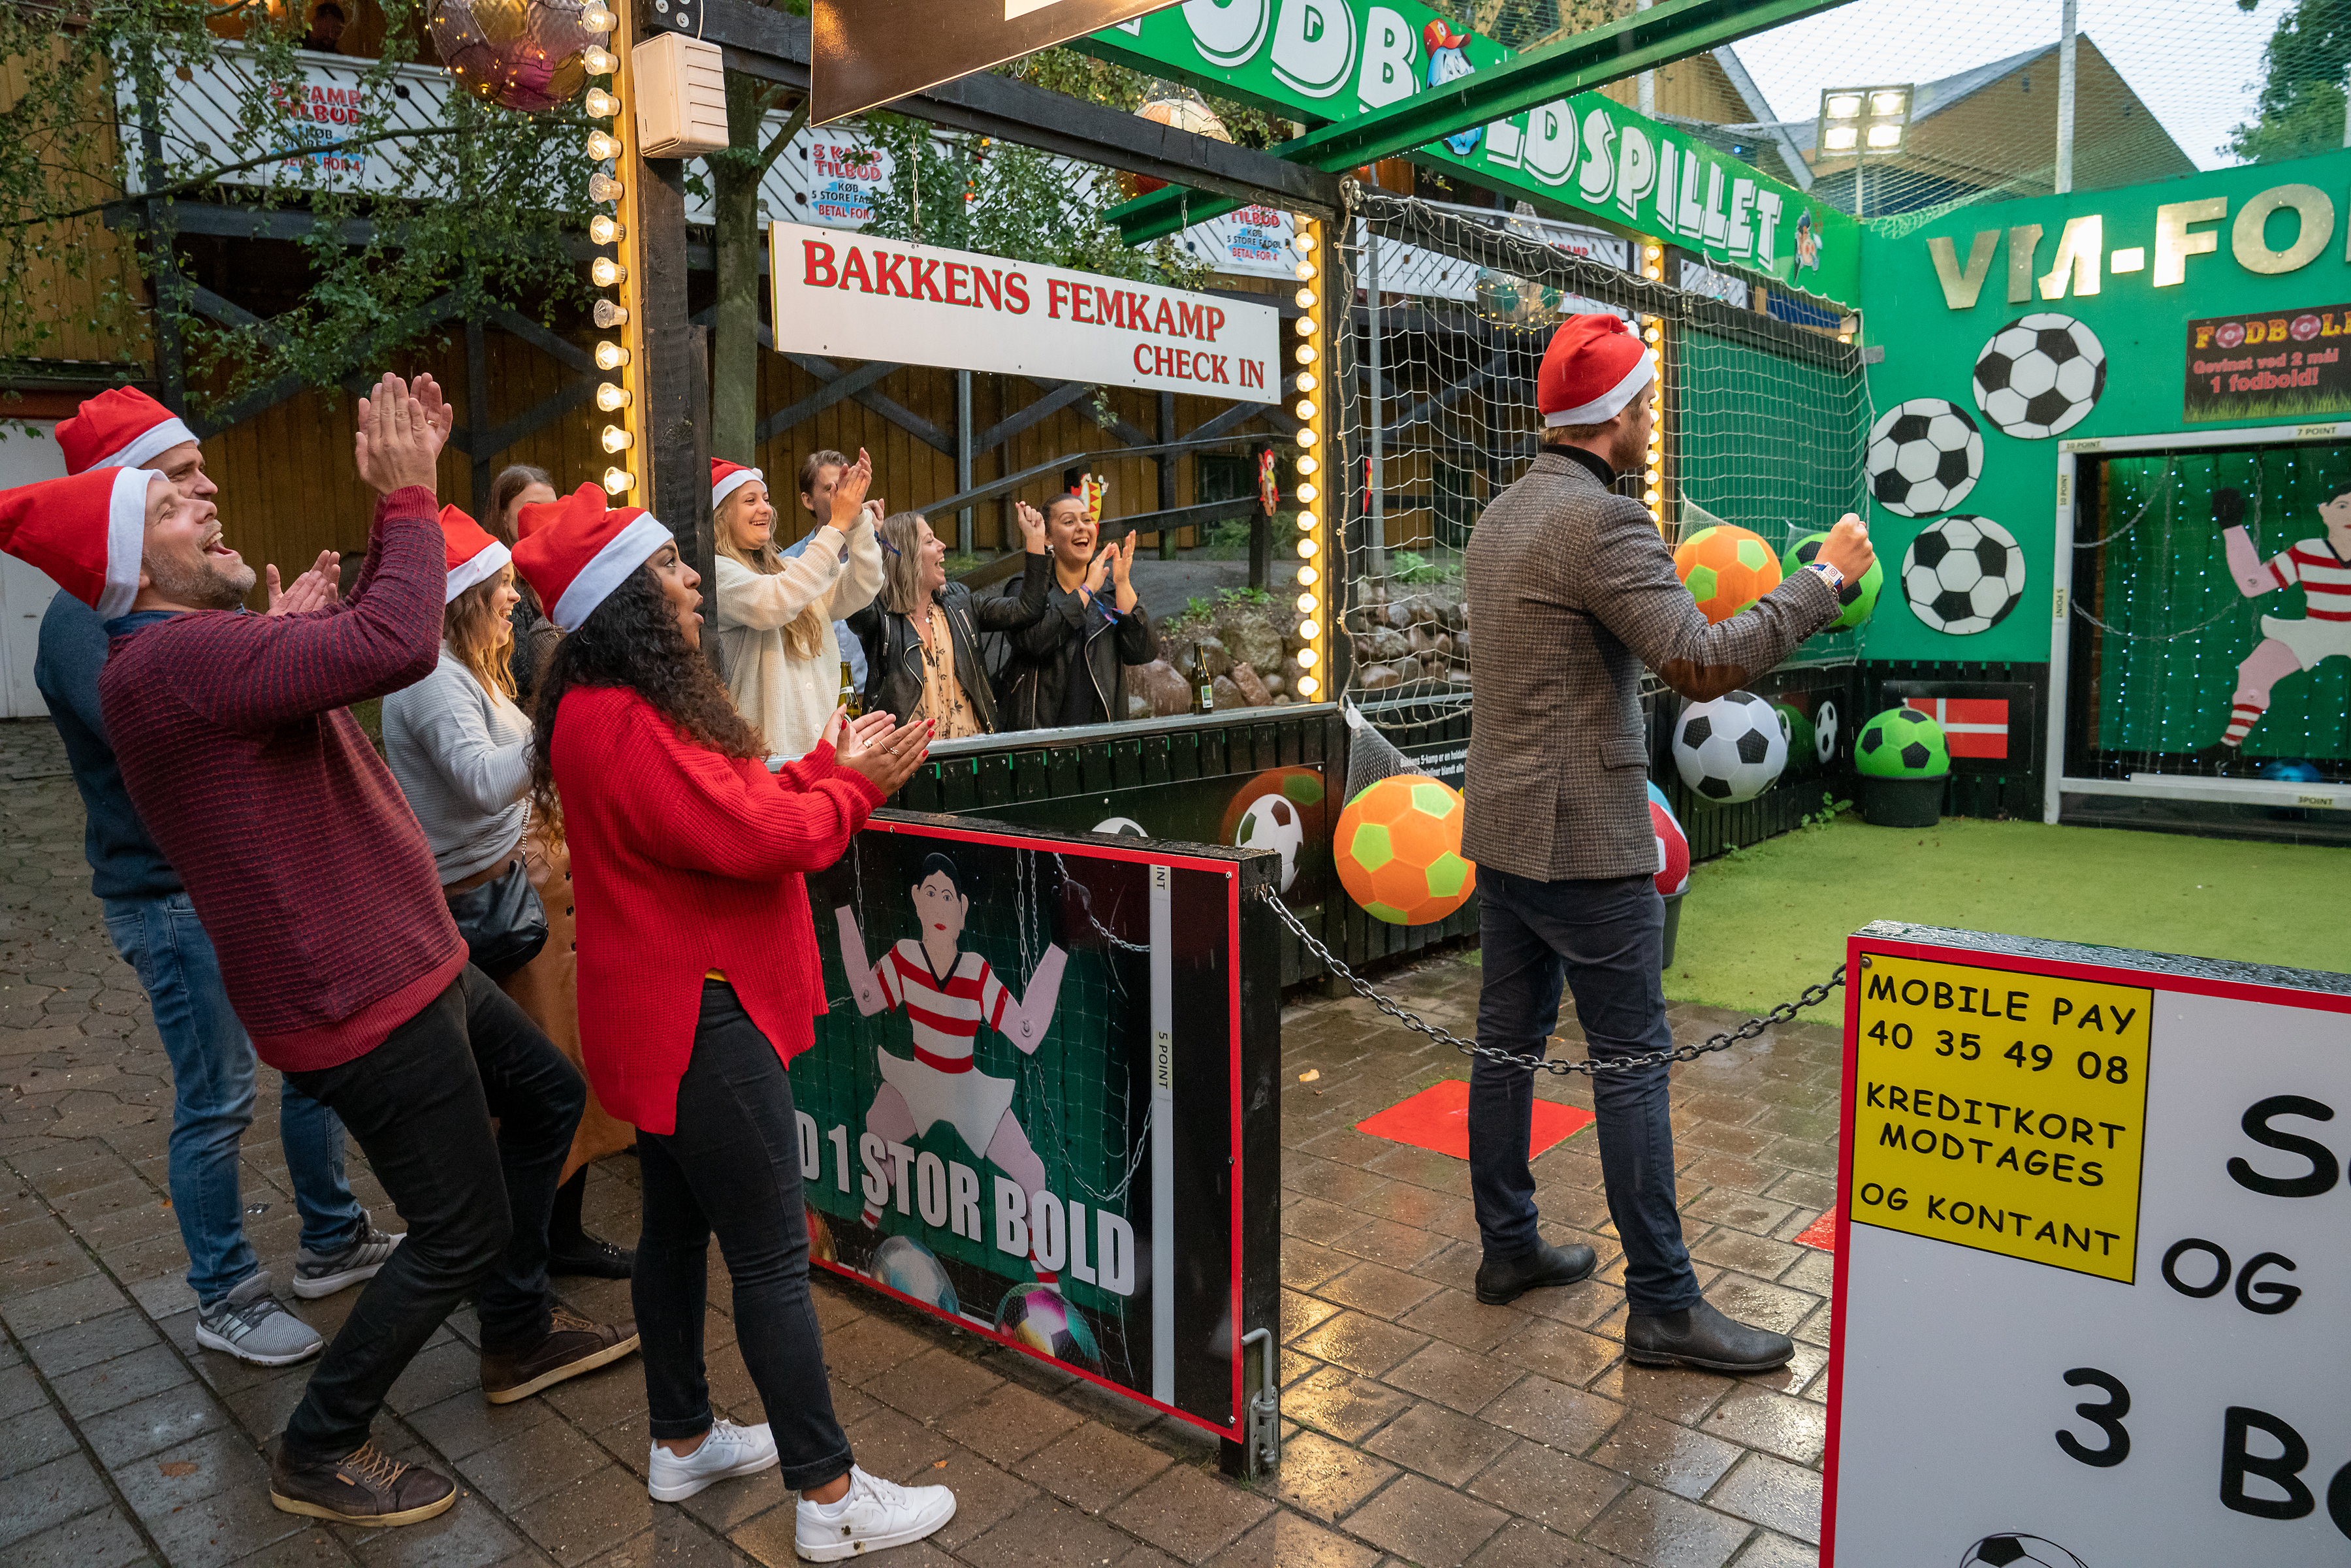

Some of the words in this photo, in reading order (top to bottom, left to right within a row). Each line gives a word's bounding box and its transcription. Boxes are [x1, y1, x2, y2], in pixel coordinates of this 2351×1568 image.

[300, 85, 362, 106] AMP
[813, 144, 824, 159] 5
[830, 146, 882, 165] KP
[814, 160, 882, 181] TILBUD
[820, 191, 850, 202] STORE
[838, 183, 858, 193] KØB
[819, 204, 847, 217] BETAL
[850, 208, 869, 220] FOR
[1230, 210, 1280, 227] TILBUD
[1234, 236, 1256, 246] STORE
[1247, 229, 1263, 238] KØB
[1232, 248, 1253, 259] BETAL
[1256, 250, 1271, 261] FOR
[802, 240, 1031, 315] BAKKENS
[1047, 278, 1225, 342] FEMKAMP
[2195, 311, 2351, 349] FODBOL
[1134, 344, 1228, 385] CHECK
[1239, 359, 1264, 389] IN
[2193, 357, 2253, 374] Gevinst
[2257, 353, 2286, 369] ved
[2291, 352, 2303, 366] 2
[2307, 348, 2339, 364] mål
[2211, 376, 2220, 393] 1
[2229, 367, 2318, 392] fodbold!
[2305, 426, 2336, 435] POINT
[2076, 440, 2101, 449] POINT
[1421, 754, 1439, 765] 5-kamp
[1867, 974, 2030, 1022] MOBILE
[2052, 997, 2136, 1036] PAY
[1867, 1019, 1913, 1050] 40
[1935, 1030, 1981, 1061] 35
[2003, 1040, 2053, 1072] 49
[2077, 1051, 2129, 1085] 08
[1159, 1044, 1168, 1089] POINT
[1866, 1081, 2126, 1149] KREDITKORT
[1879, 1122, 2104, 1187] MODTAGES
[2226, 1095, 2351, 1198] S
[828, 1124, 850, 1194] 1
[859, 1132, 980, 1243] STOR
[995, 1175, 1135, 1296] BOLD
[1860, 1182, 1908, 1211] OG
[1928, 1195, 2120, 1256] KONTANT
[2161, 1238, 2302, 1315] OG
[2055, 1367, 2131, 1468] 3
[2220, 1405, 2351, 1543] B
